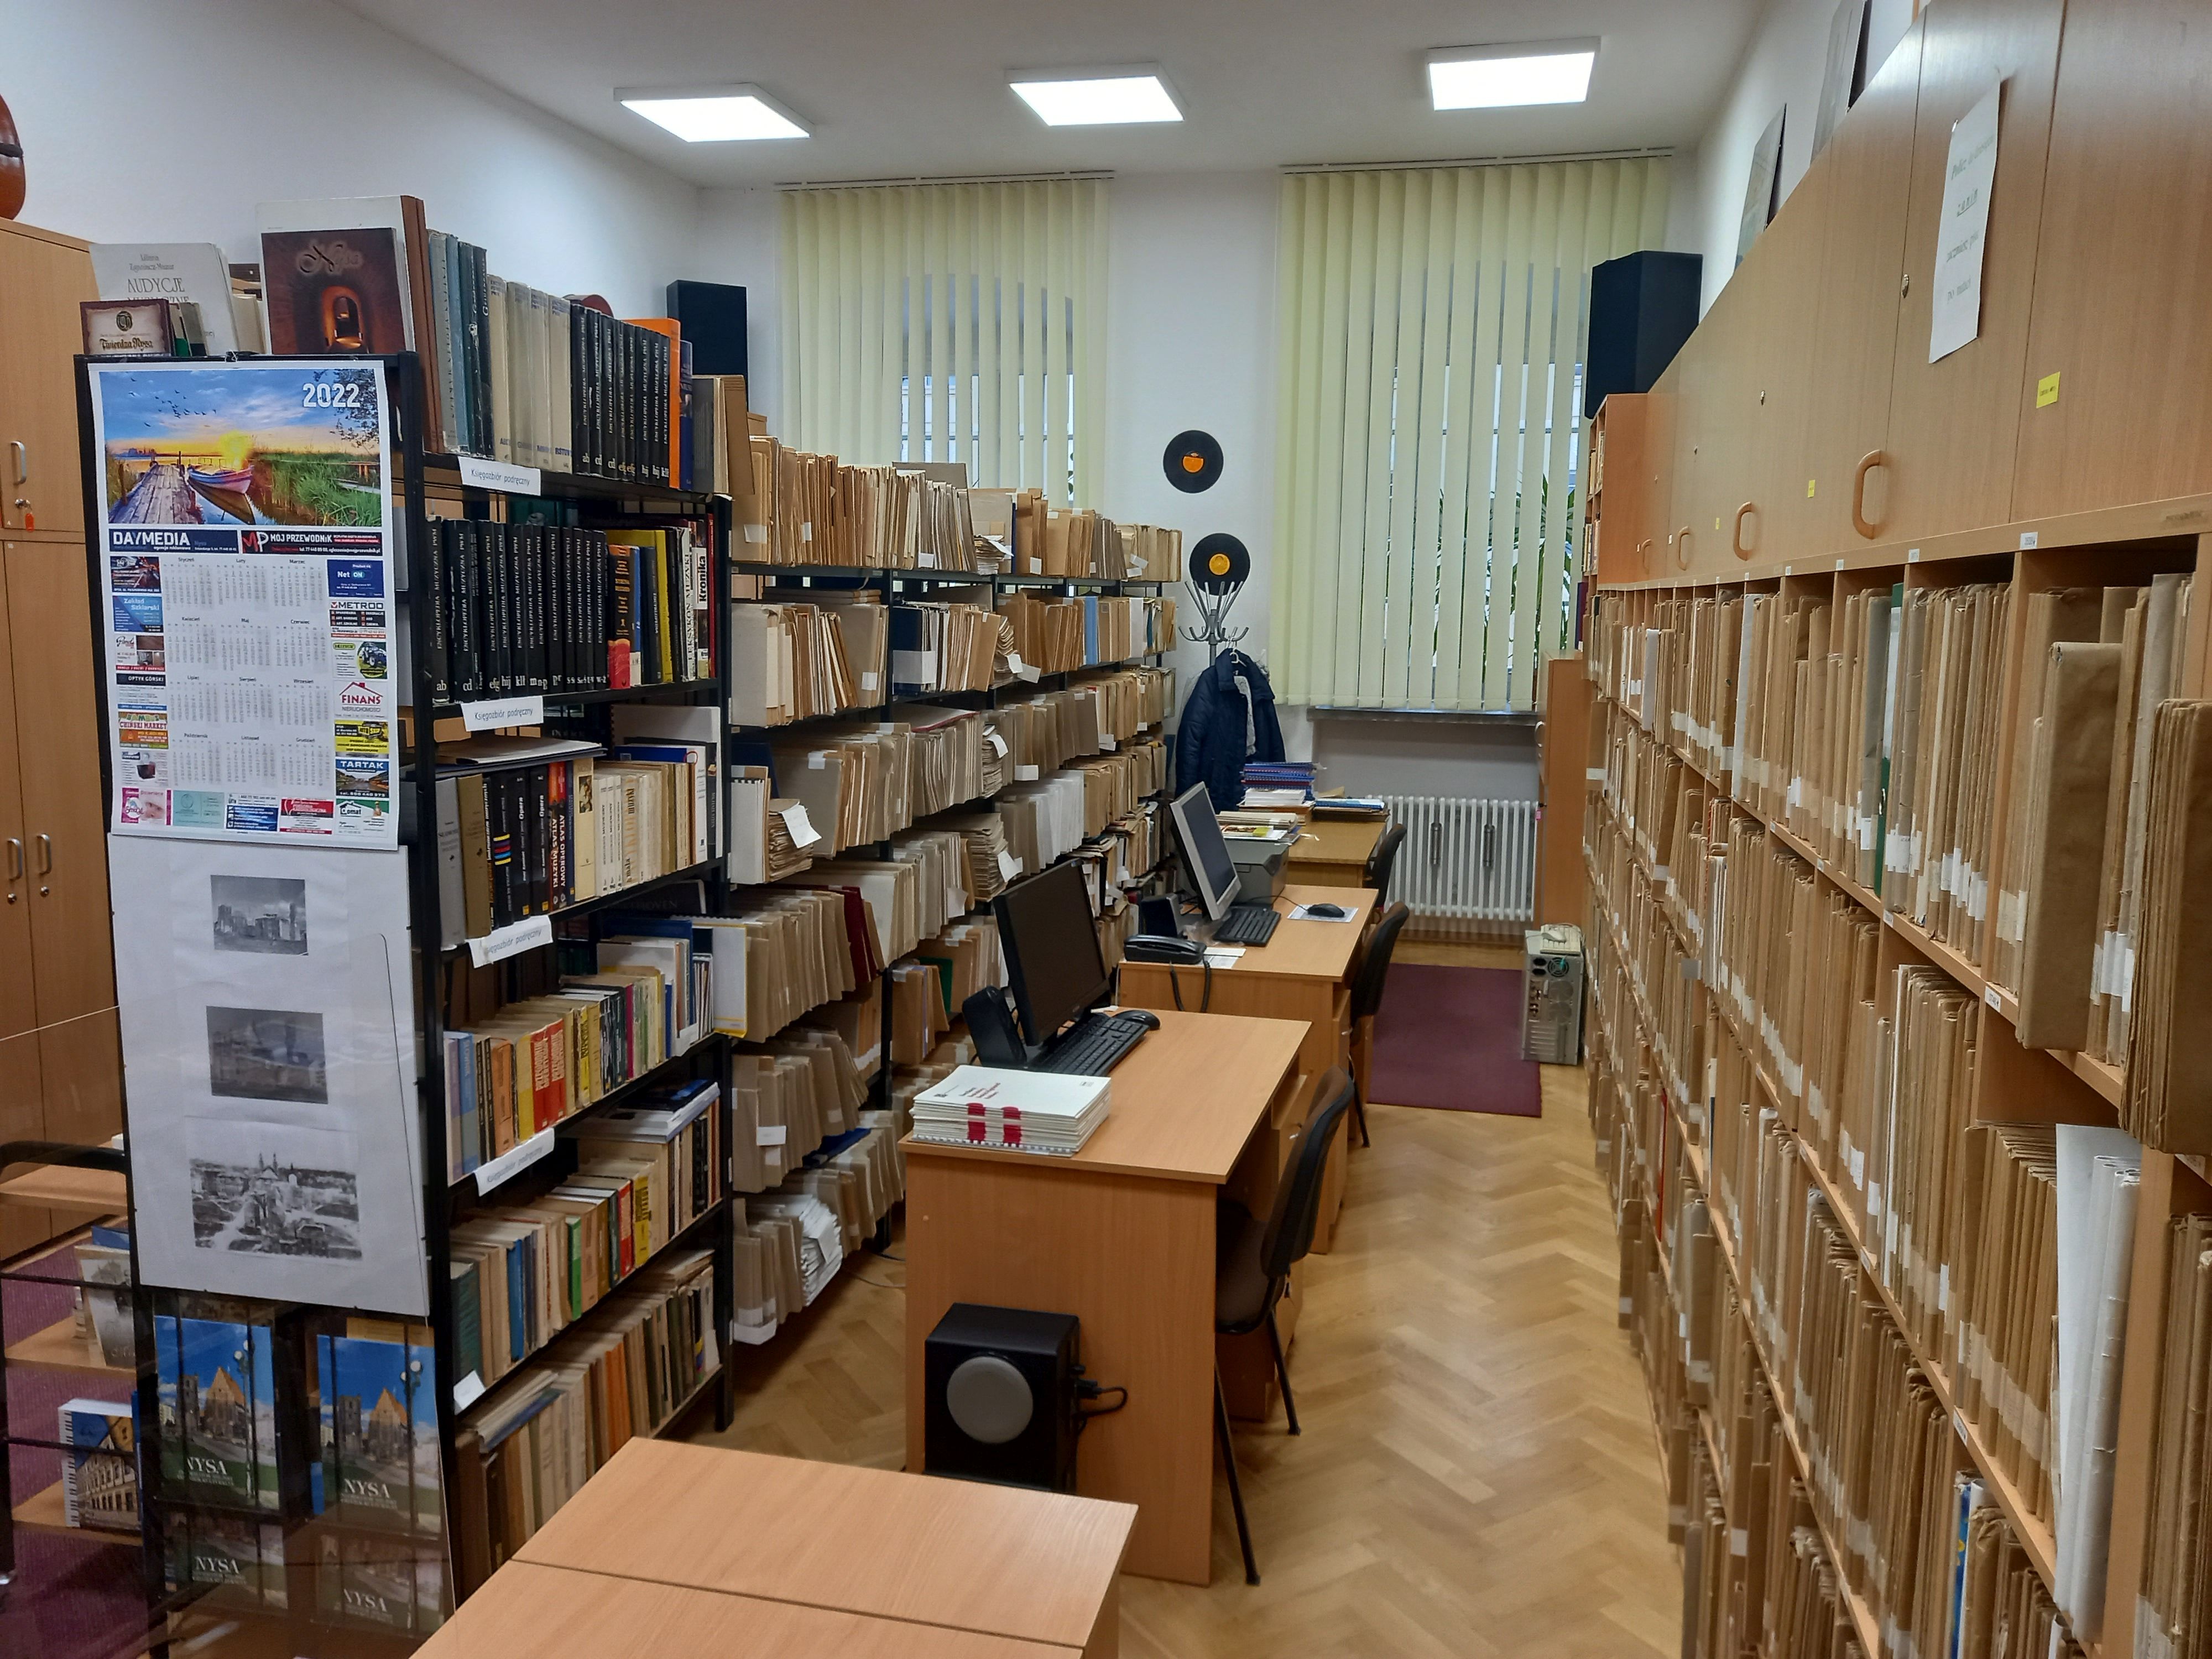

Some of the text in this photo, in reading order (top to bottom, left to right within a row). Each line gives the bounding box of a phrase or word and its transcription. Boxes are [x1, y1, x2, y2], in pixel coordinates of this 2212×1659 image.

[128, 278, 185, 293] AUDYCJE
[100, 337, 154, 351] Twierdza Nysa
[303, 383, 360, 408] 2022
[471, 468, 530, 486] Księgozbiór podręczny
[113, 531, 191, 545] DAYMEDIA
[698, 555, 707, 603] Kronika
[342, 695, 380, 705] FINANS
[474, 708, 533, 722] Księgozbiór podręczny
[515, 929, 541, 945] podręczny
[187, 1456, 227, 1475] NYSA
[344, 1478, 390, 1499] NYSA
[195, 1555, 239, 1574] NYSA
